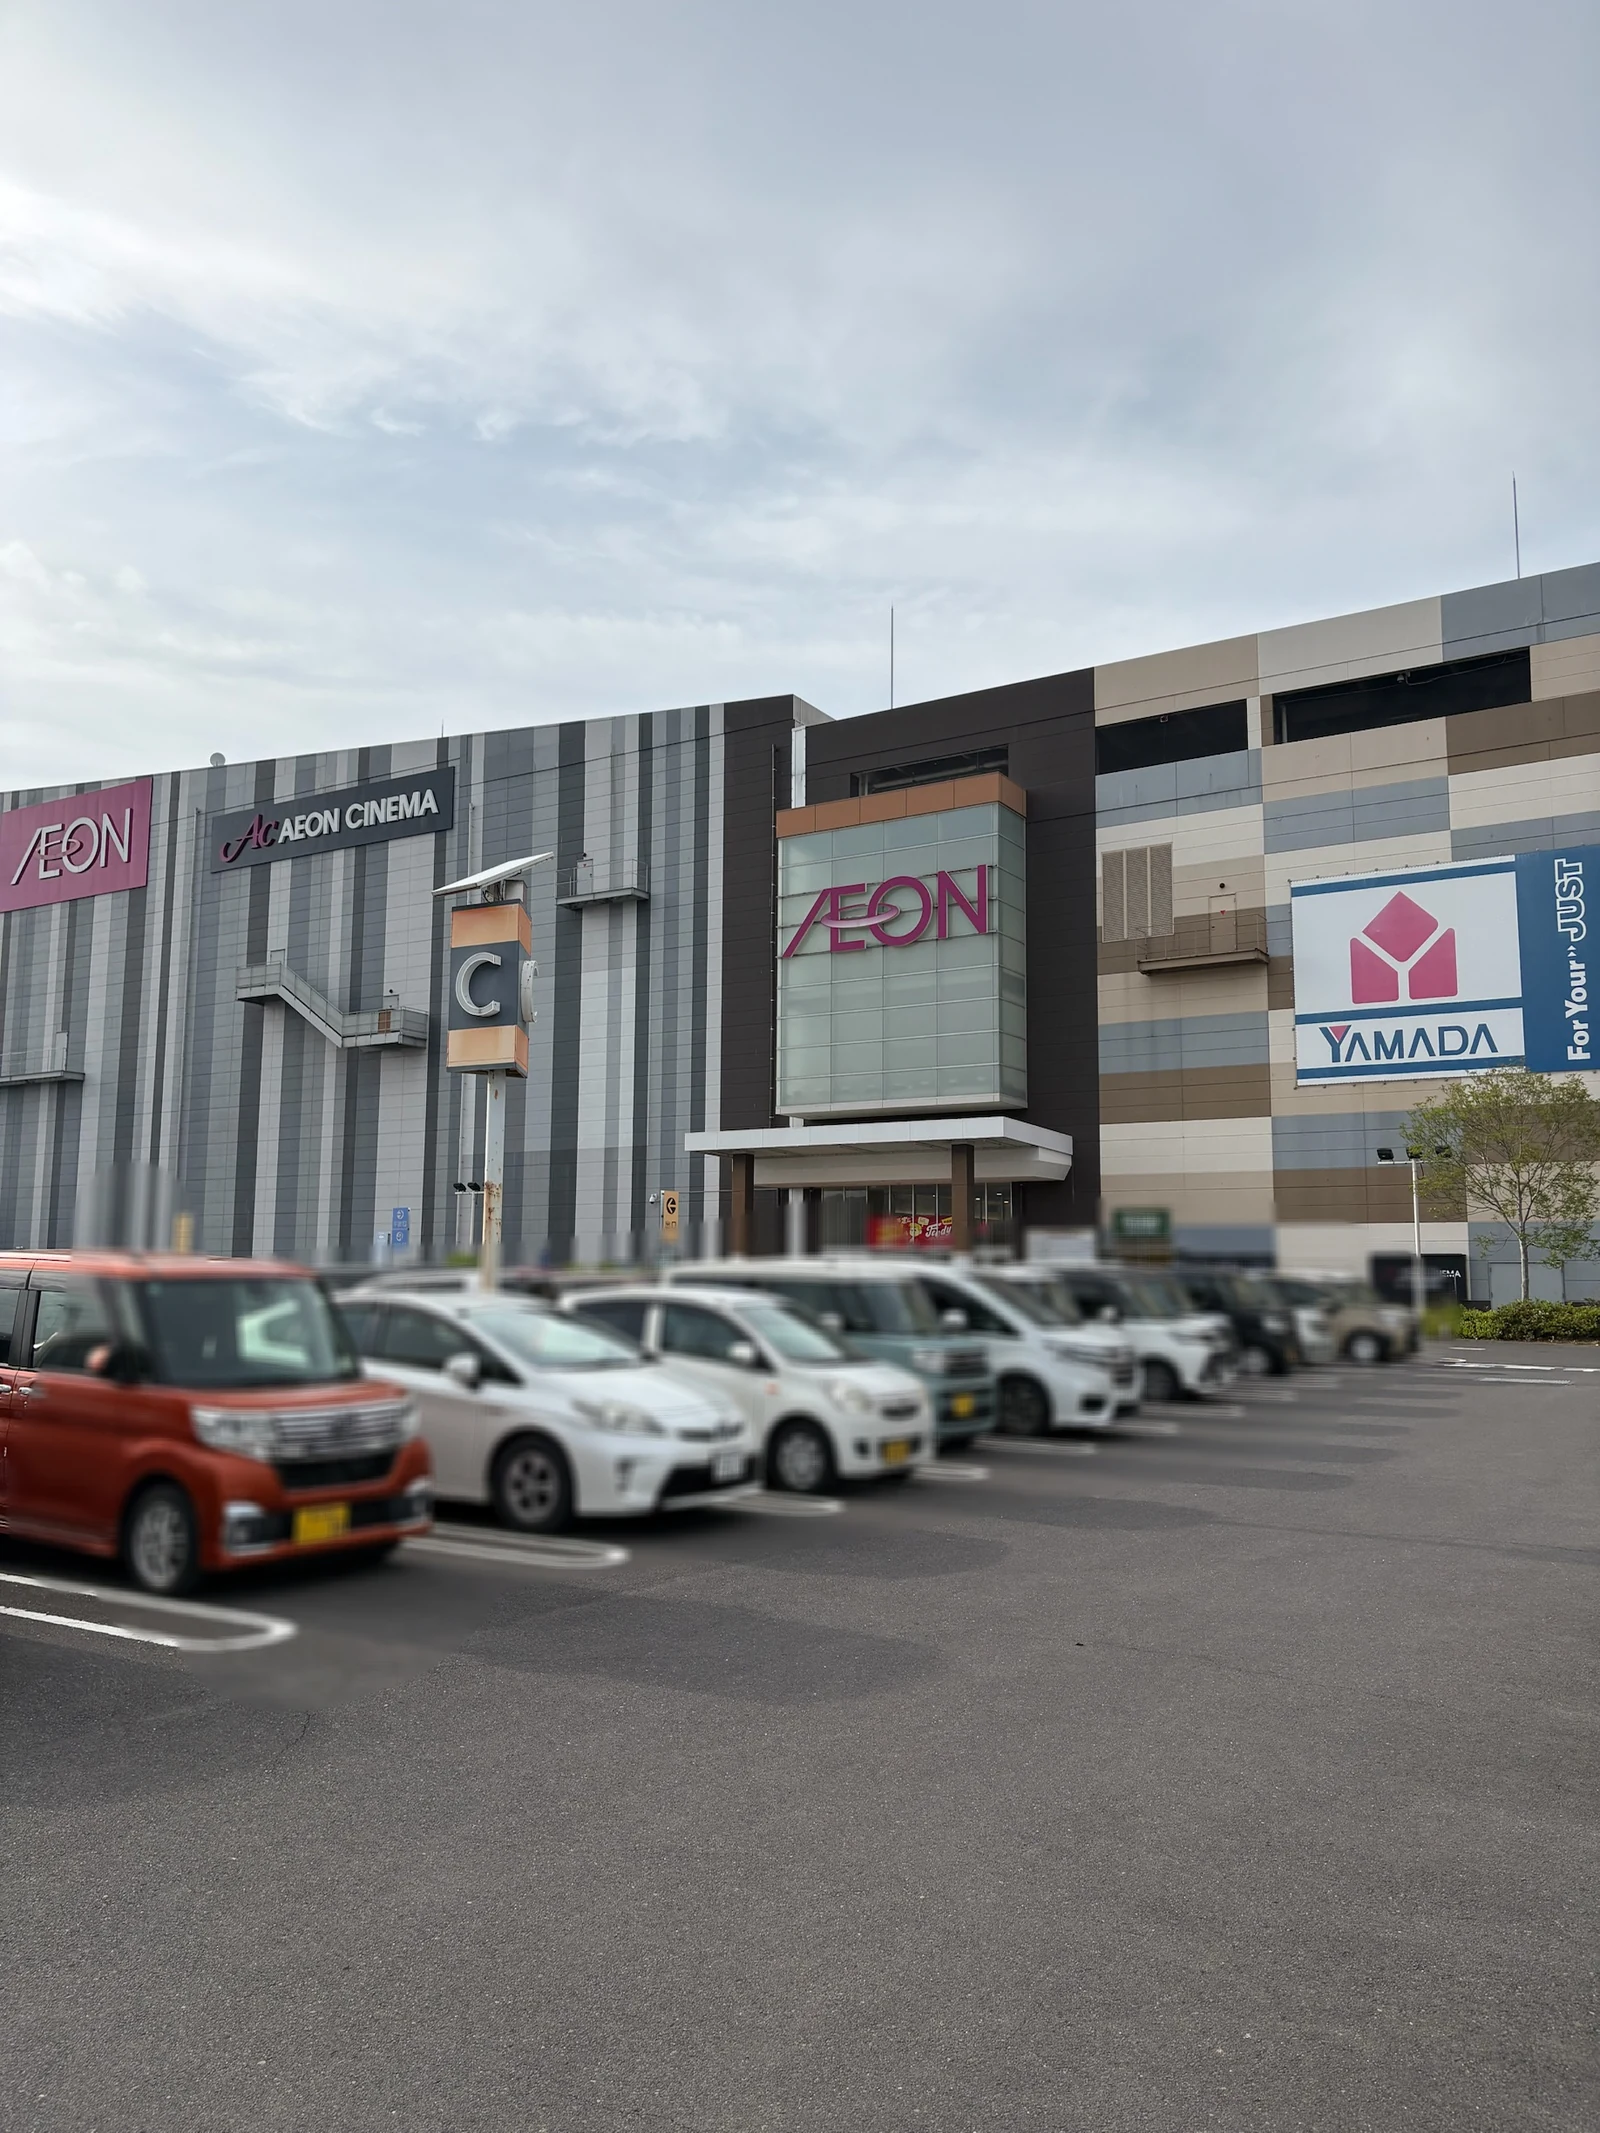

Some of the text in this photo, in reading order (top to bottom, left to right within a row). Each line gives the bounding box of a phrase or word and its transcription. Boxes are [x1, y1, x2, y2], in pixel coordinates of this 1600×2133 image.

[278, 807, 341, 845] AEON
[345, 788, 439, 830] CINEMA
[455, 951, 501, 1017] C
[1554, 858, 1591, 1061] For Your JUST
[1319, 1024, 1499, 1063] YAMADA
